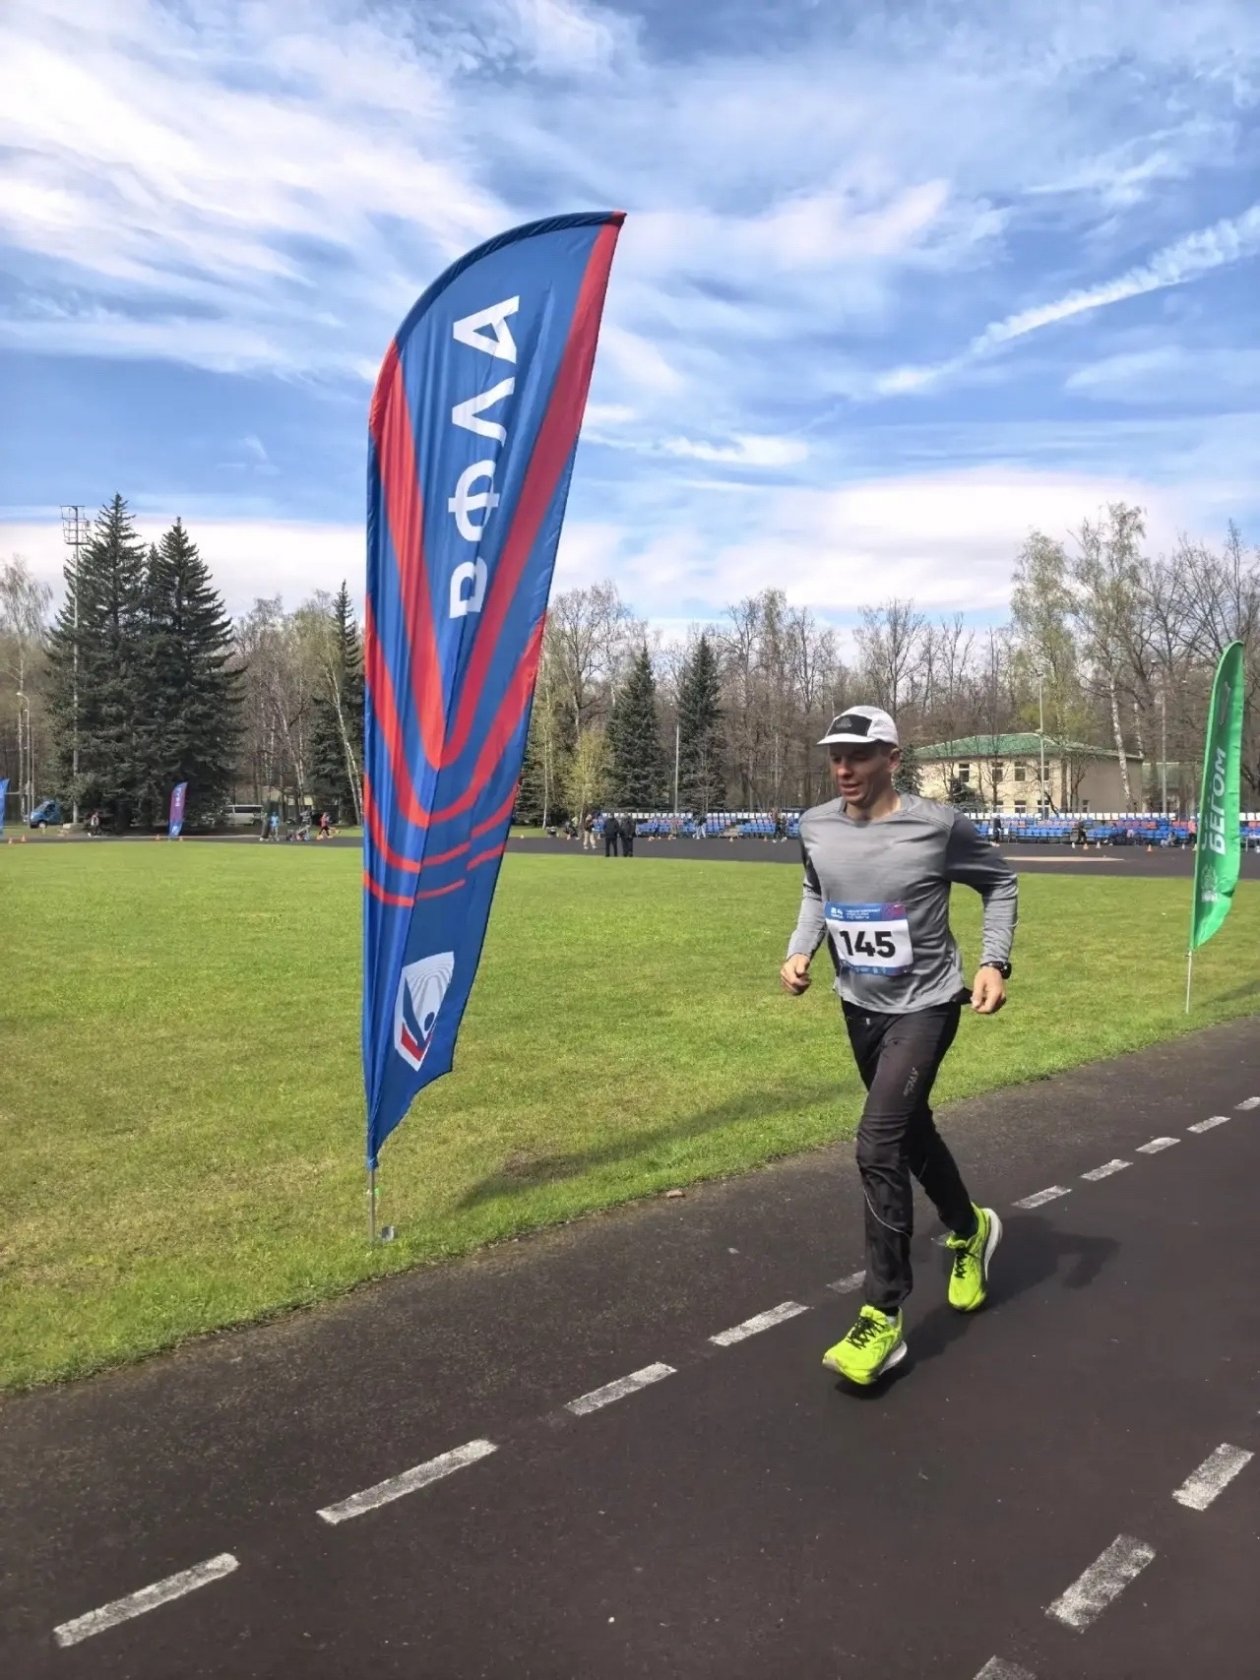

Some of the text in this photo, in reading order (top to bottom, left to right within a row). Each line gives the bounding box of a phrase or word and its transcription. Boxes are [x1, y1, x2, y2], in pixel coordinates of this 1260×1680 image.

[448, 295, 520, 619] ВФЛА
[1210, 747, 1227, 855] БЕГОМ
[839, 930, 896, 959] 145
